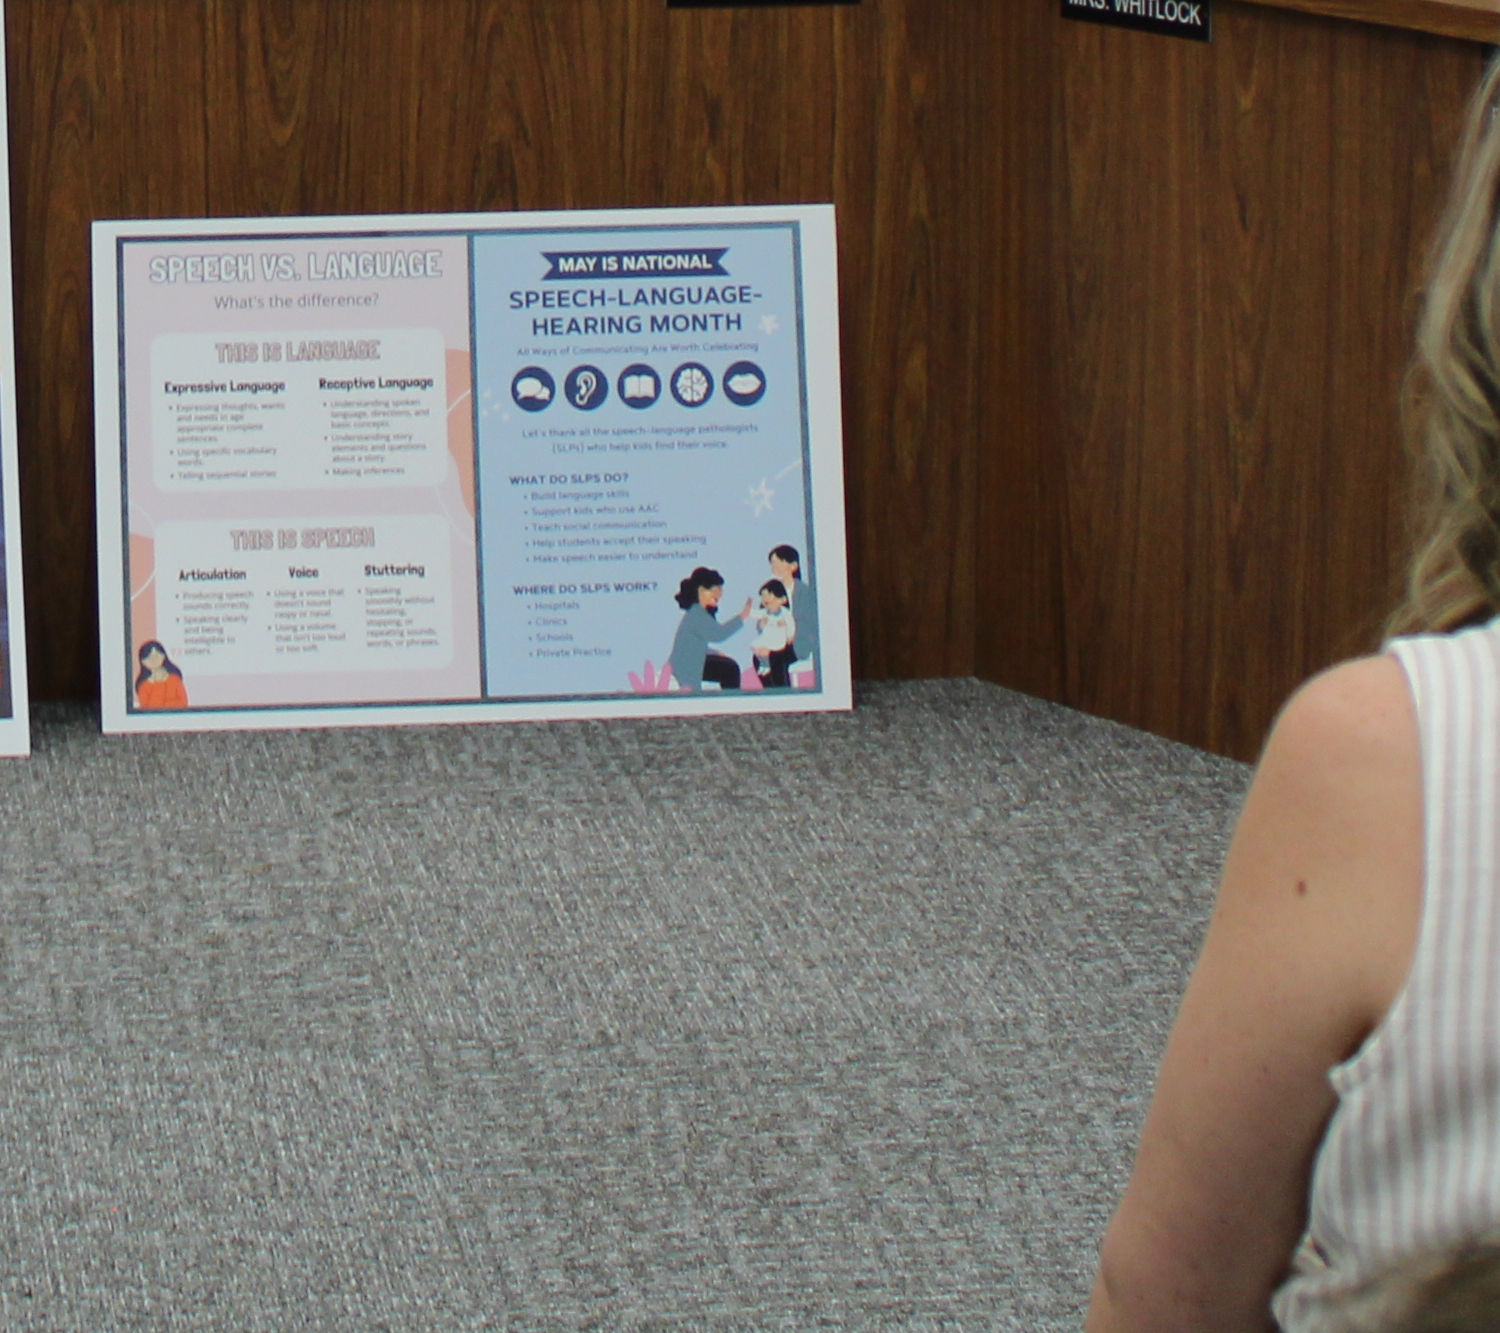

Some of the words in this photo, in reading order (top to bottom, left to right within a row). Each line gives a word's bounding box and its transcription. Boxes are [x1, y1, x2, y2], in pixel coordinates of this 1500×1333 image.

[150, 254, 254, 283] SPEECH
[261, 253, 300, 281] VS.
[308, 250, 442, 281] LANGUAGE
[558, 257, 597, 272] MAY
[602, 256, 618, 271] IS
[622, 254, 712, 270] NATIONAL
[215, 295, 264, 309] What's
[268, 294, 292, 308] the
[298, 293, 379, 308] difference?
[509, 285, 763, 309] SPEECH-LANGUAGE-
[532, 315, 642, 336] HEARING
[650, 313, 742, 333] MONTH
[216, 343, 258, 363] THIS
[263, 342, 282, 362] IS
[286, 339, 381, 361] LANGUAGE
[517, 347, 529, 356] All
[531, 347, 557, 357] Ways
[560, 345, 571, 355] of
[572, 344, 649, 355] Communicating
[651, 344, 668, 353] Are
[670, 343, 700, 352] Worth
[702, 342, 759, 353] Celebrating
[164, 380, 227, 394] Expressive
[230, 380, 285, 394] Language
[319, 377, 376, 391] Receptive
[378, 376, 434, 390] Language
[549, 428, 576, 437] thank
[580, 427, 591, 436] all
[593, 427, 610, 436] the
[698, 423, 758, 435] pathologists
[587, 443, 607, 452] who
[609, 442, 631, 453] help
[633, 441, 652, 450] kids
[655, 440, 675, 450] find
[677, 440, 699, 449] their
[509, 475, 546, 486] WHAT
[550, 474, 567, 484] DO
[571, 473, 600, 484] SLPS
[604, 472, 629, 483] DO?
[531, 491, 556, 501] Build
[558, 490, 604, 502] language
[606, 489, 630, 498] skills
[532, 506, 572, 518] Support
[574, 505, 593, 515] kids
[596, 505, 616, 514] who
[618, 506, 636, 514] use
[638, 503, 659, 513] AAC
[532, 522, 560, 532] Teach
[563, 521, 591, 531] social
[593, 519, 667, 530] communication
[231, 529, 274, 550] THIS
[278, 529, 297, 550] IS
[301, 527, 375, 549] SPEECH
[533, 538, 555, 549] Help
[557, 537, 600, 547] students
[603, 536, 635, 547] accept
[637, 535, 660, 544] their
[663, 534, 707, 545] speaking
[534, 554, 559, 563] Make
[561, 552, 596, 564] speech
[598, 552, 626, 561] easier
[629, 551, 639, 560] to
[641, 550, 698, 560] understand
[179, 568, 247, 582] Articulation
[289, 566, 319, 579] Voice
[365, 563, 425, 578] Stuttering
[513, 585, 556, 595] WHERE
[559, 584, 577, 594] DO
[581, 583, 610, 594] SLPS
[614, 582, 658, 592] WORK?
[535, 601, 580, 611] Hospitals
[536, 617, 567, 626] Clinics
[536, 633, 573, 642] Schools
[537, 648, 570, 658] Private
[573, 647, 612, 656] Practice
